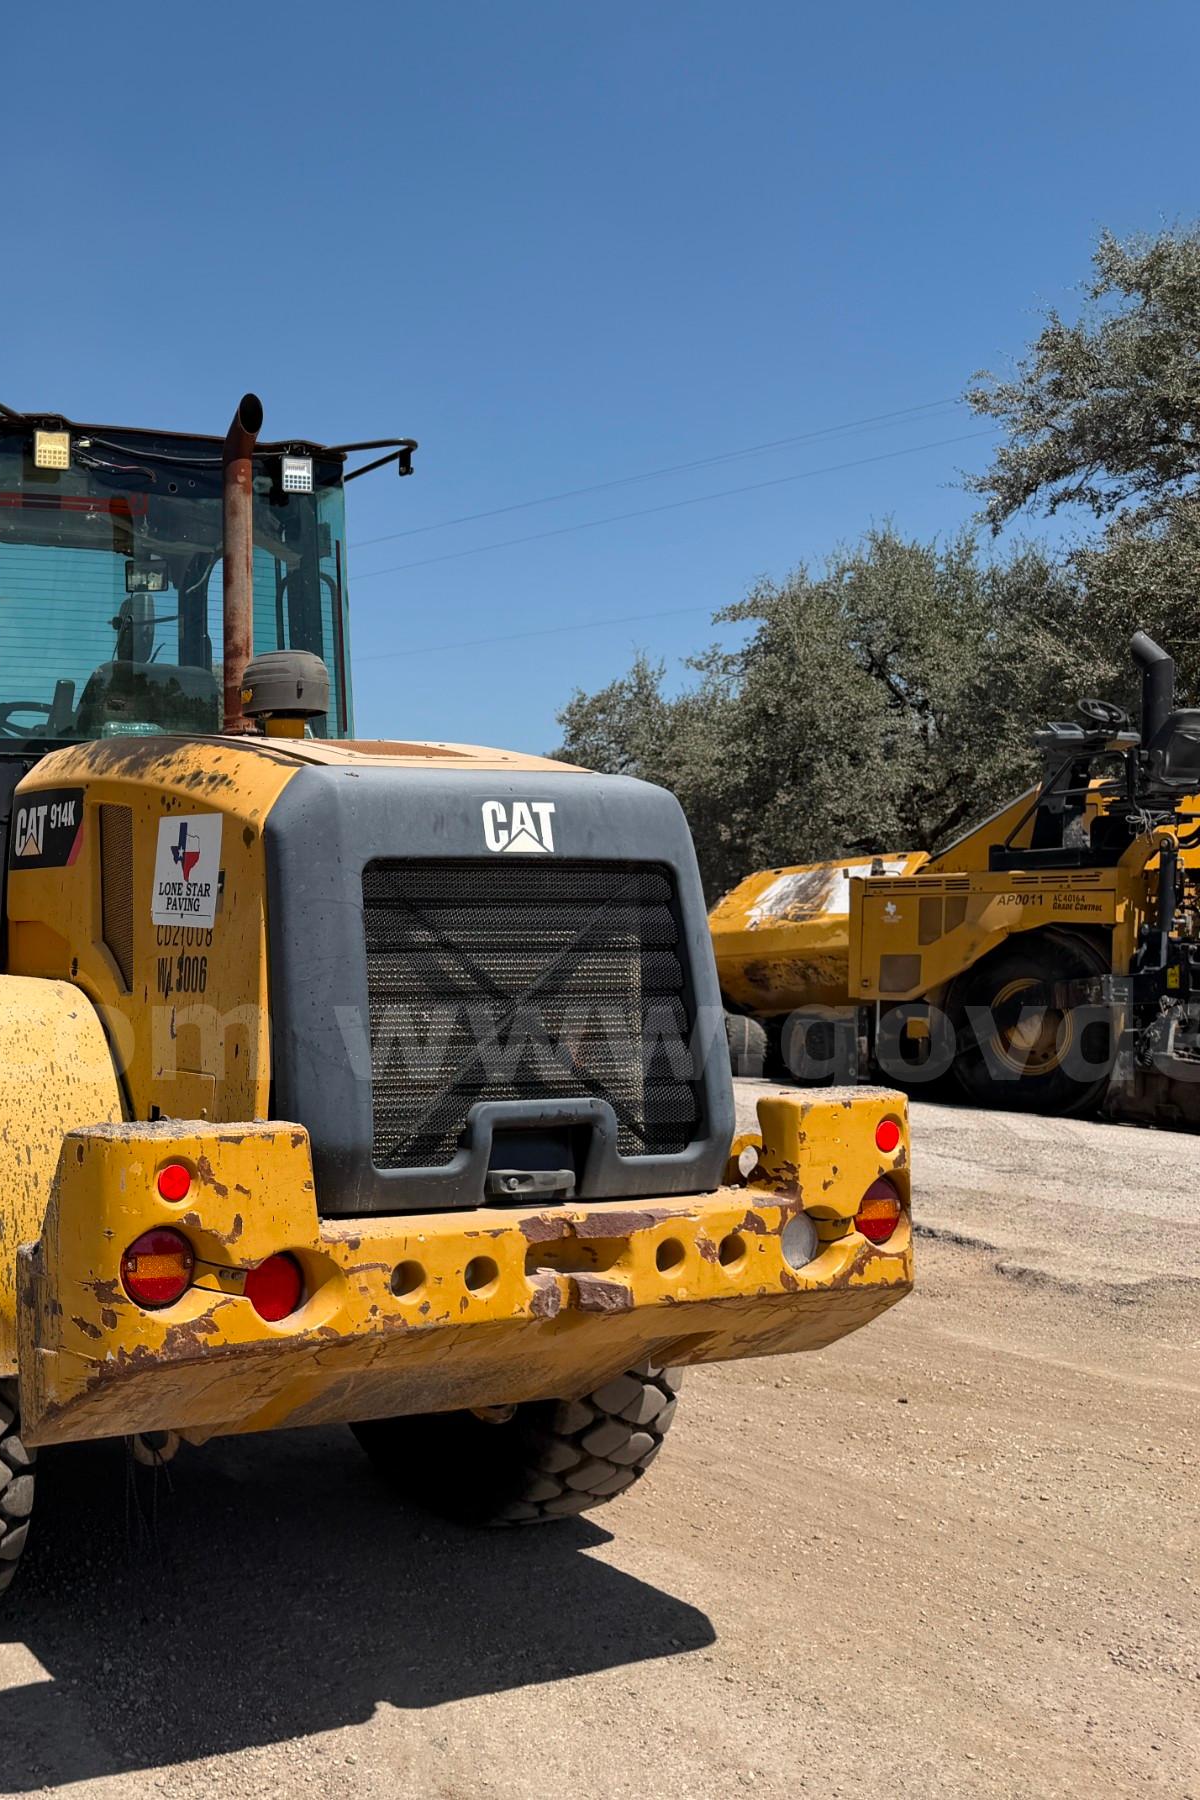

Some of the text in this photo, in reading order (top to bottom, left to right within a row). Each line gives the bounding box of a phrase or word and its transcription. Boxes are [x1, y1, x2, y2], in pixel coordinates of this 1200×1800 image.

[15, 800, 76, 857] CAT 914K
[481, 800, 556, 853] CAT
[159, 882, 211, 897] LONE STAR
[997, 894, 1043, 905] AP0011
[166, 897, 201, 912] PAVING
[157, 956, 208, 993] WL 3006
